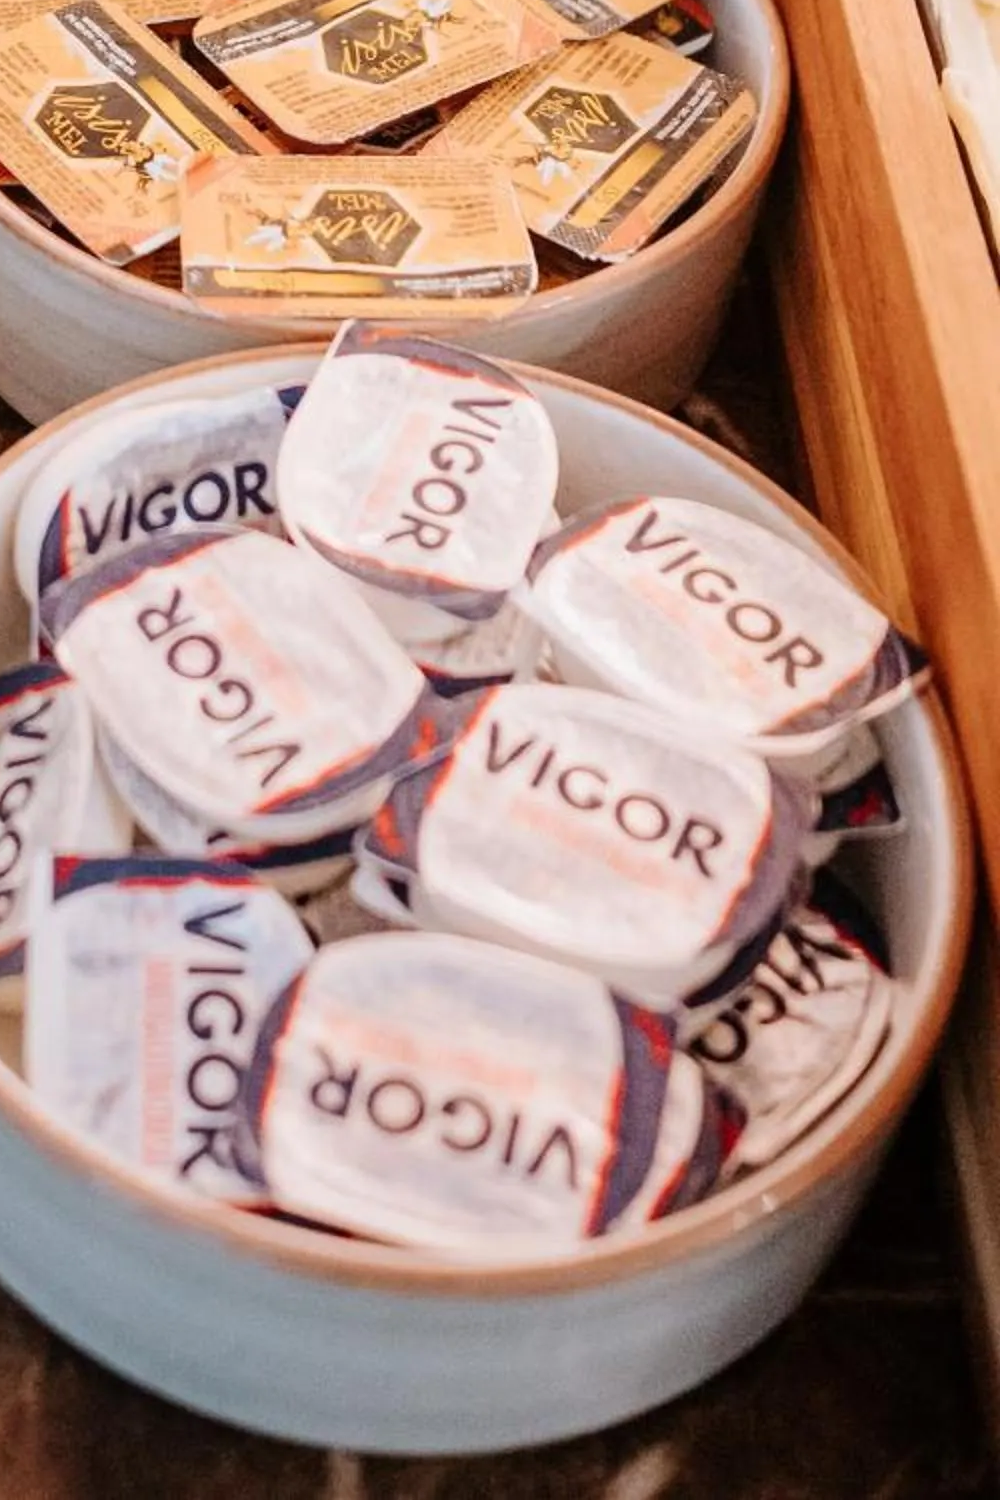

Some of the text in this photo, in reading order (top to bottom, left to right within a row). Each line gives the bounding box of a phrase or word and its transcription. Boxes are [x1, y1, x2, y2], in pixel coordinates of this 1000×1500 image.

[44, 111, 90, 155] MEL
[370, 49, 423, 81] MEL
[327, 193, 386, 212] MEL
[77, 462, 275, 555] VIGOR
[386, 399, 514, 551] VIGOR
[624, 510, 825, 689] VIGOR
[137, 587, 300, 787] VIGOR
[484, 721, 725, 878] VIGOR
[180, 901, 248, 1177] VIGOR
[690, 924, 853, 1063] VIGO
[309, 1045, 582, 1190] VIGOR
